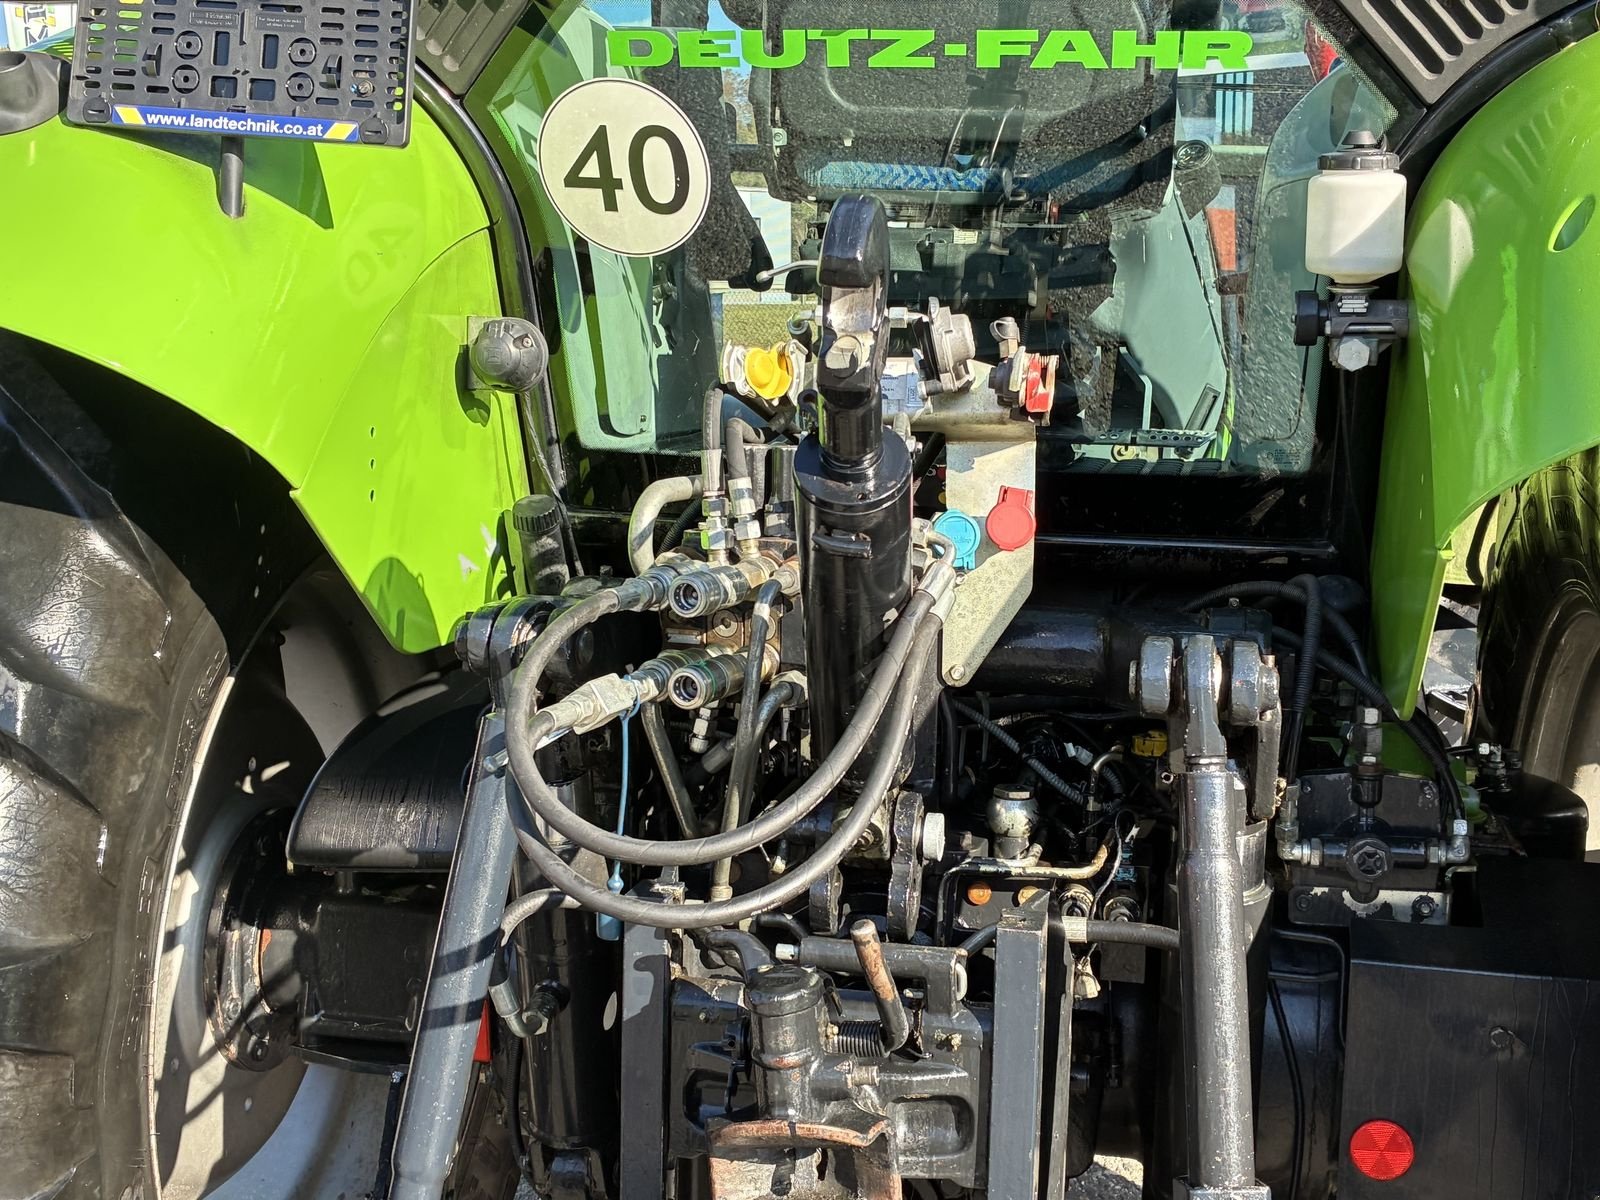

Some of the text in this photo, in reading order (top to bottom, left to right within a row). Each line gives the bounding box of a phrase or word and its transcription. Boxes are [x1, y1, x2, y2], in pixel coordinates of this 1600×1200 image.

[607, 29, 1253, 69] DEUTZ-FAHR
[146, 114, 323, 137] www.landtechnik.co.at
[563, 124, 690, 216] 40
